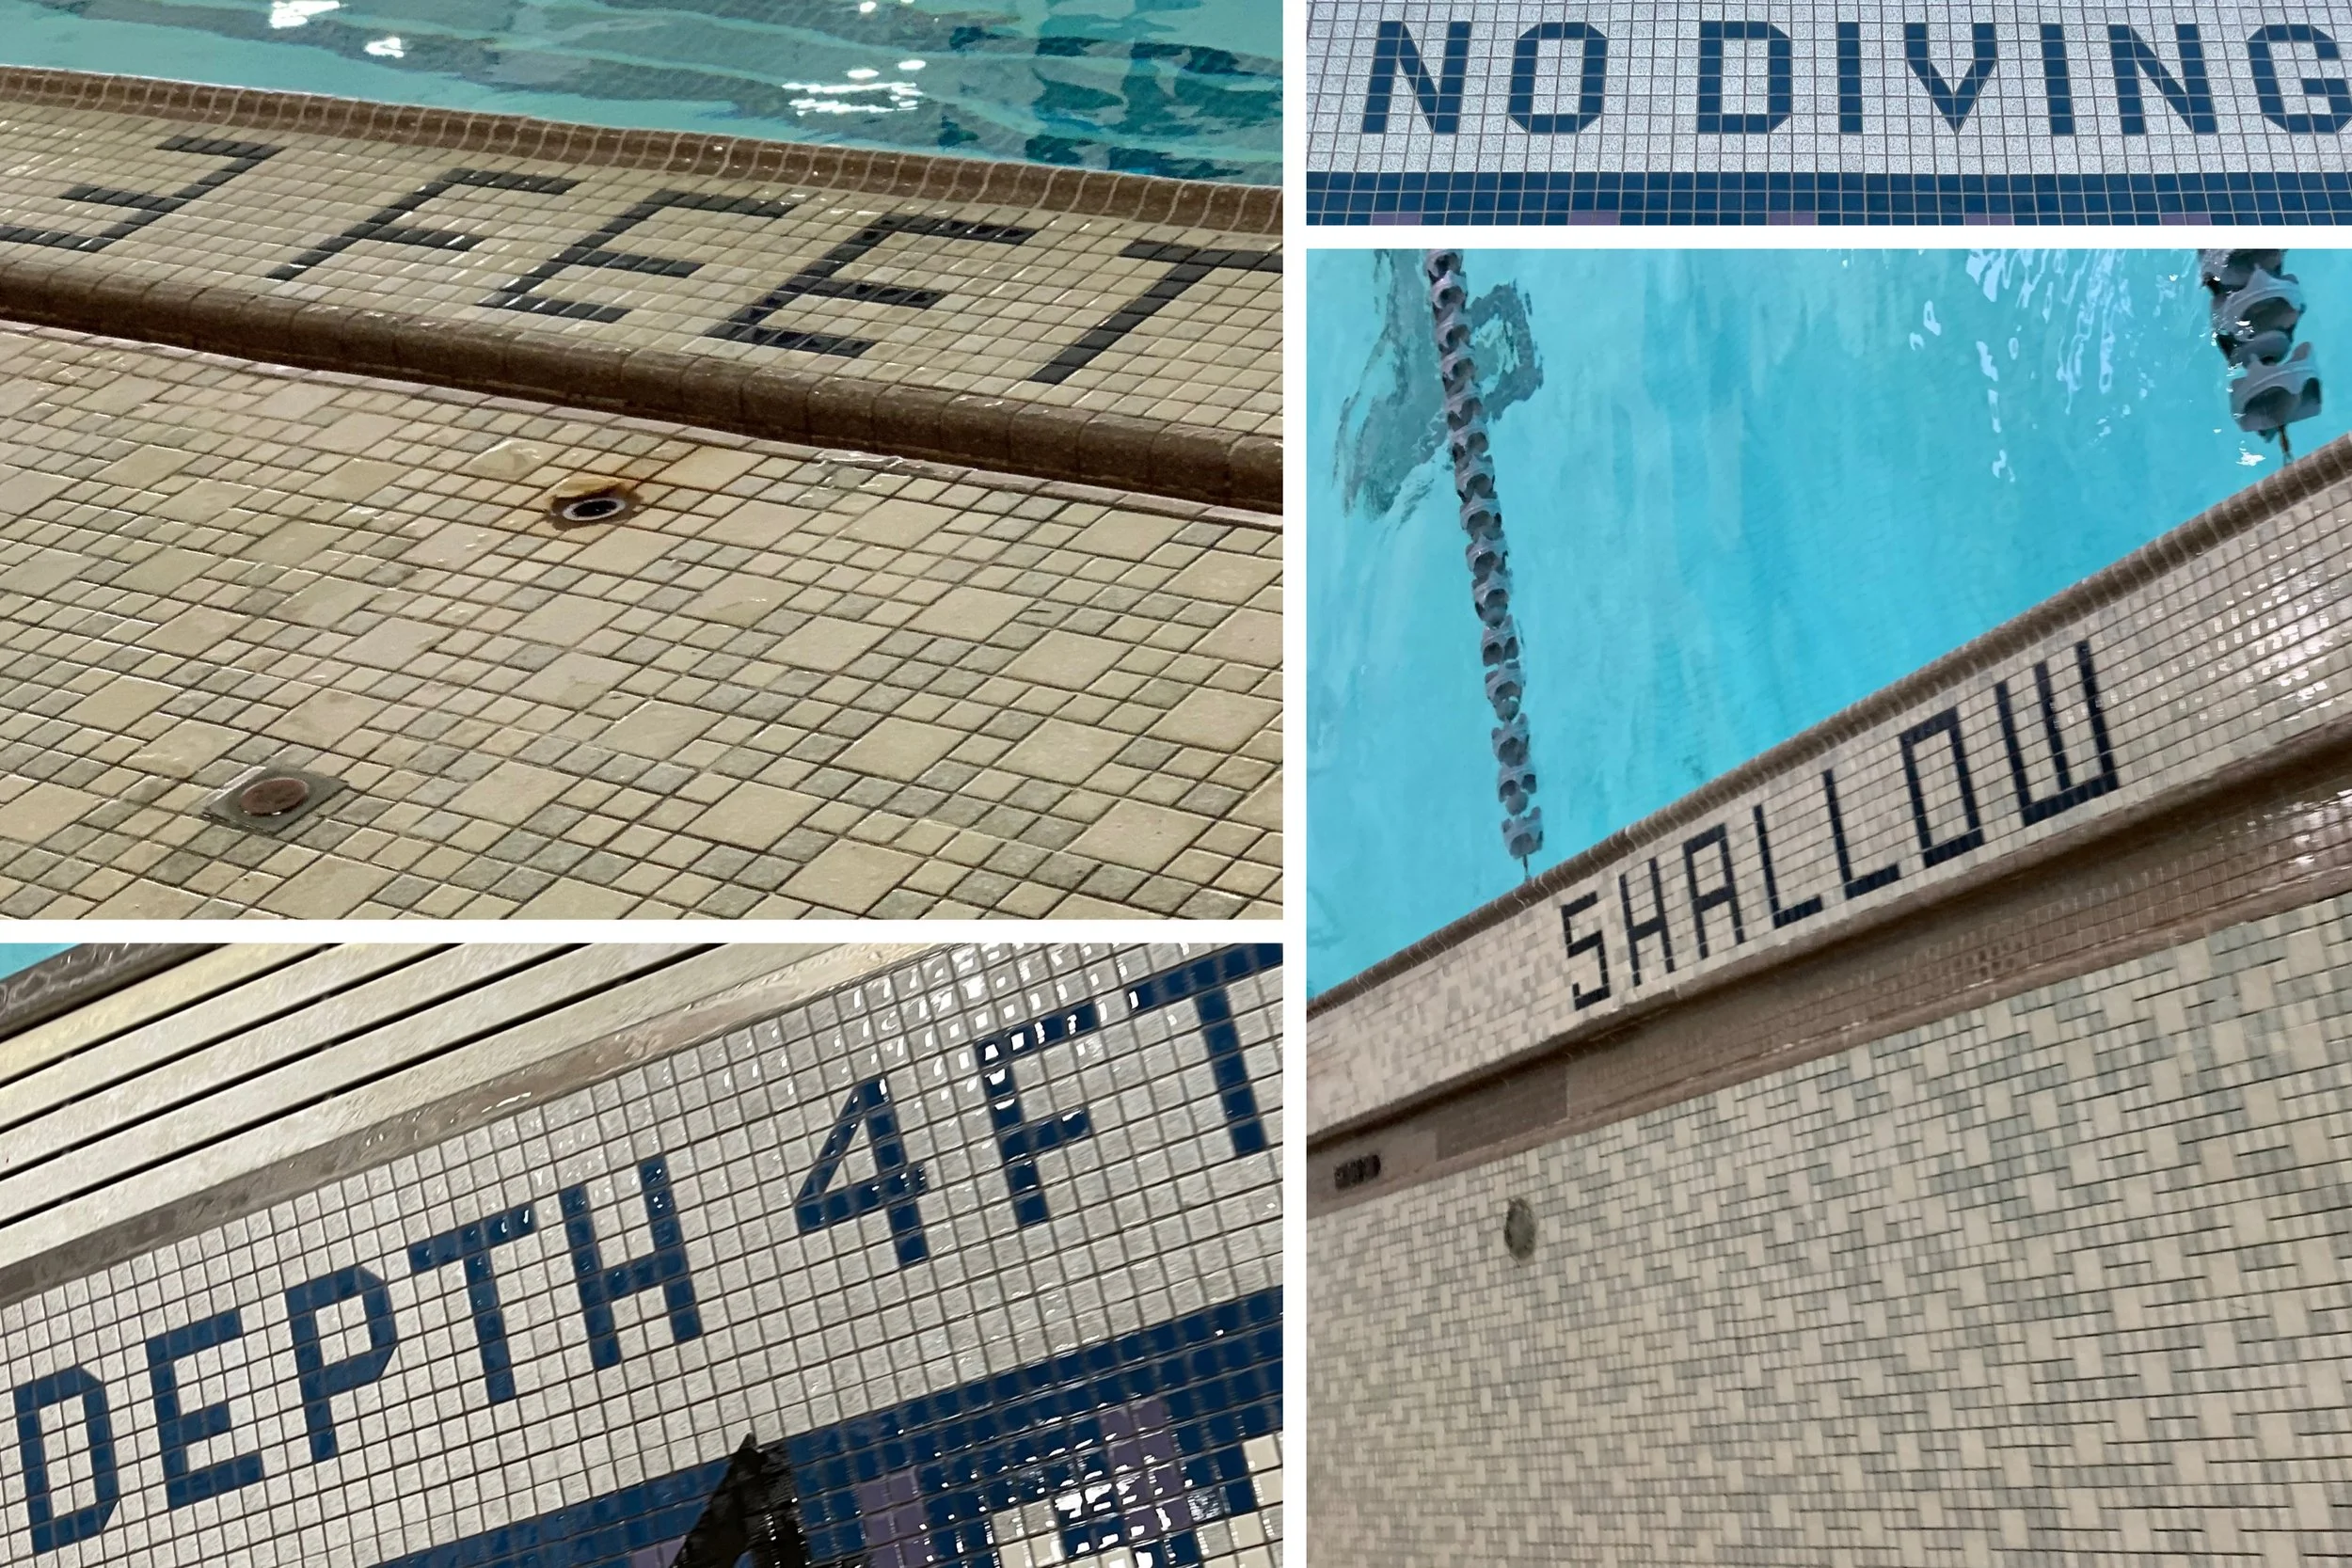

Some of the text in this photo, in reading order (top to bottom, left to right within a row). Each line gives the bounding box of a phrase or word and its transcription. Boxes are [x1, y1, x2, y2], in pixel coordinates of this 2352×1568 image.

[1361, 21, 2352, 135] NO DIVING
[263, 167, 1283, 385] FEET
[1560, 640, 2120, 1011] SHALLOW
[12, 943, 1283, 1555] DEPTH 4 FT
